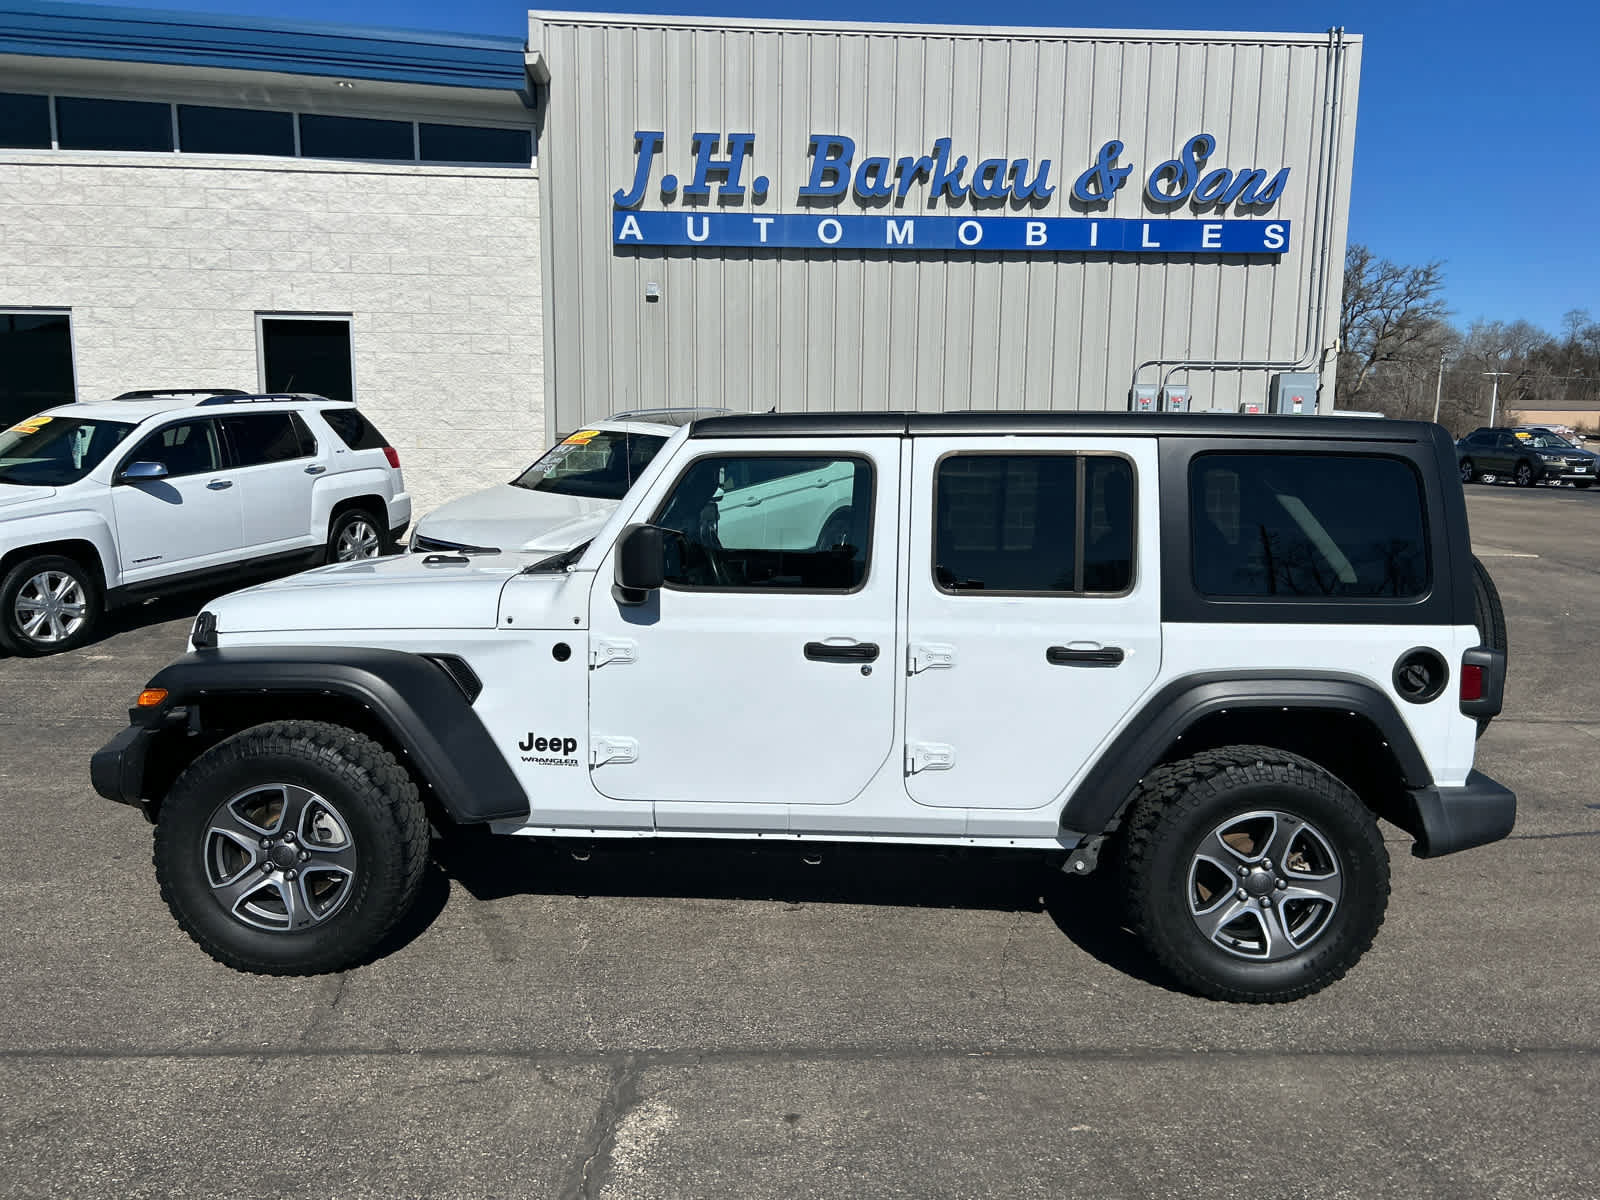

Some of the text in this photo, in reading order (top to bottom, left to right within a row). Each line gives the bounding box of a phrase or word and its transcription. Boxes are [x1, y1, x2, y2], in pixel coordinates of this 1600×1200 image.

[799, 134, 1056, 200] Barkau
[1073, 139, 1134, 201] &
[1147, 133, 1291, 205] Sons
[618, 214, 1285, 250] AUTOMOBILES
[518, 732, 577, 756] Jeep
[520, 756, 578, 764] WRANGLER
